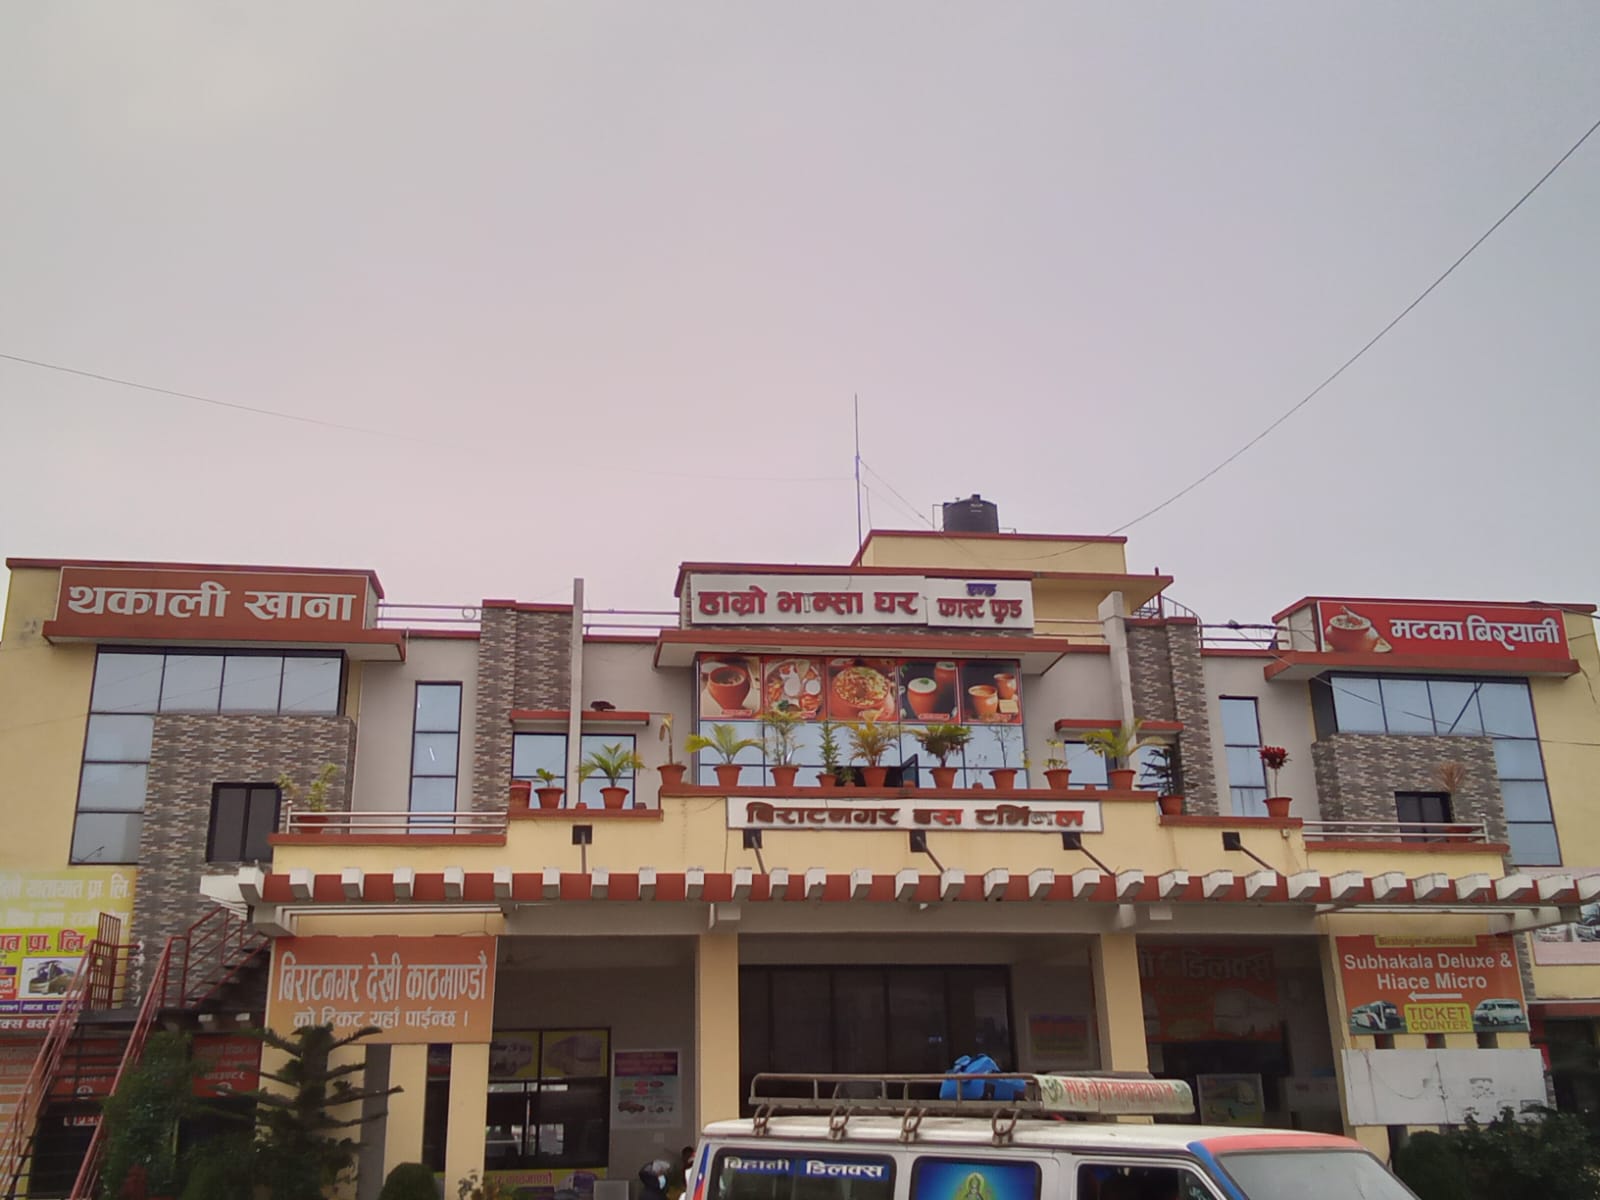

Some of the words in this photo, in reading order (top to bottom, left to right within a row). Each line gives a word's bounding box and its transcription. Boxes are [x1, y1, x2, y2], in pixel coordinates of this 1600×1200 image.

[67, 580, 230, 618] थकाली
[244, 590, 357, 621] खाना
[698, 585, 767, 616] हाम्रो
[874, 591, 920, 615] घर
[937, 598, 985, 619] फास्ट
[990, 599, 1023, 624] फुड
[1389, 619, 1463, 641] मटका
[746, 801, 900, 825] बिराटनगर
[913, 808, 963, 826] बस
[1344, 953, 1434, 970] Subhakala
[1437, 953, 1495, 969] Deluxe
[1500, 952, 1512, 968] &
[278, 951, 363, 1003] बिराटनगर
[366, 952, 402, 1003] देखी
[1377, 973, 1430, 990] Hiace
[1435, 972, 1487, 990] Micro
[369, 1006, 400, 1028] यहाँ
[405, 1006, 456, 1029] पाईन्छ
[1408, 1007, 1467, 1021] TICKET
[1411, 1020, 1468, 1031] COUNTER
[806, 1160, 884, 1177] डिलक्स
